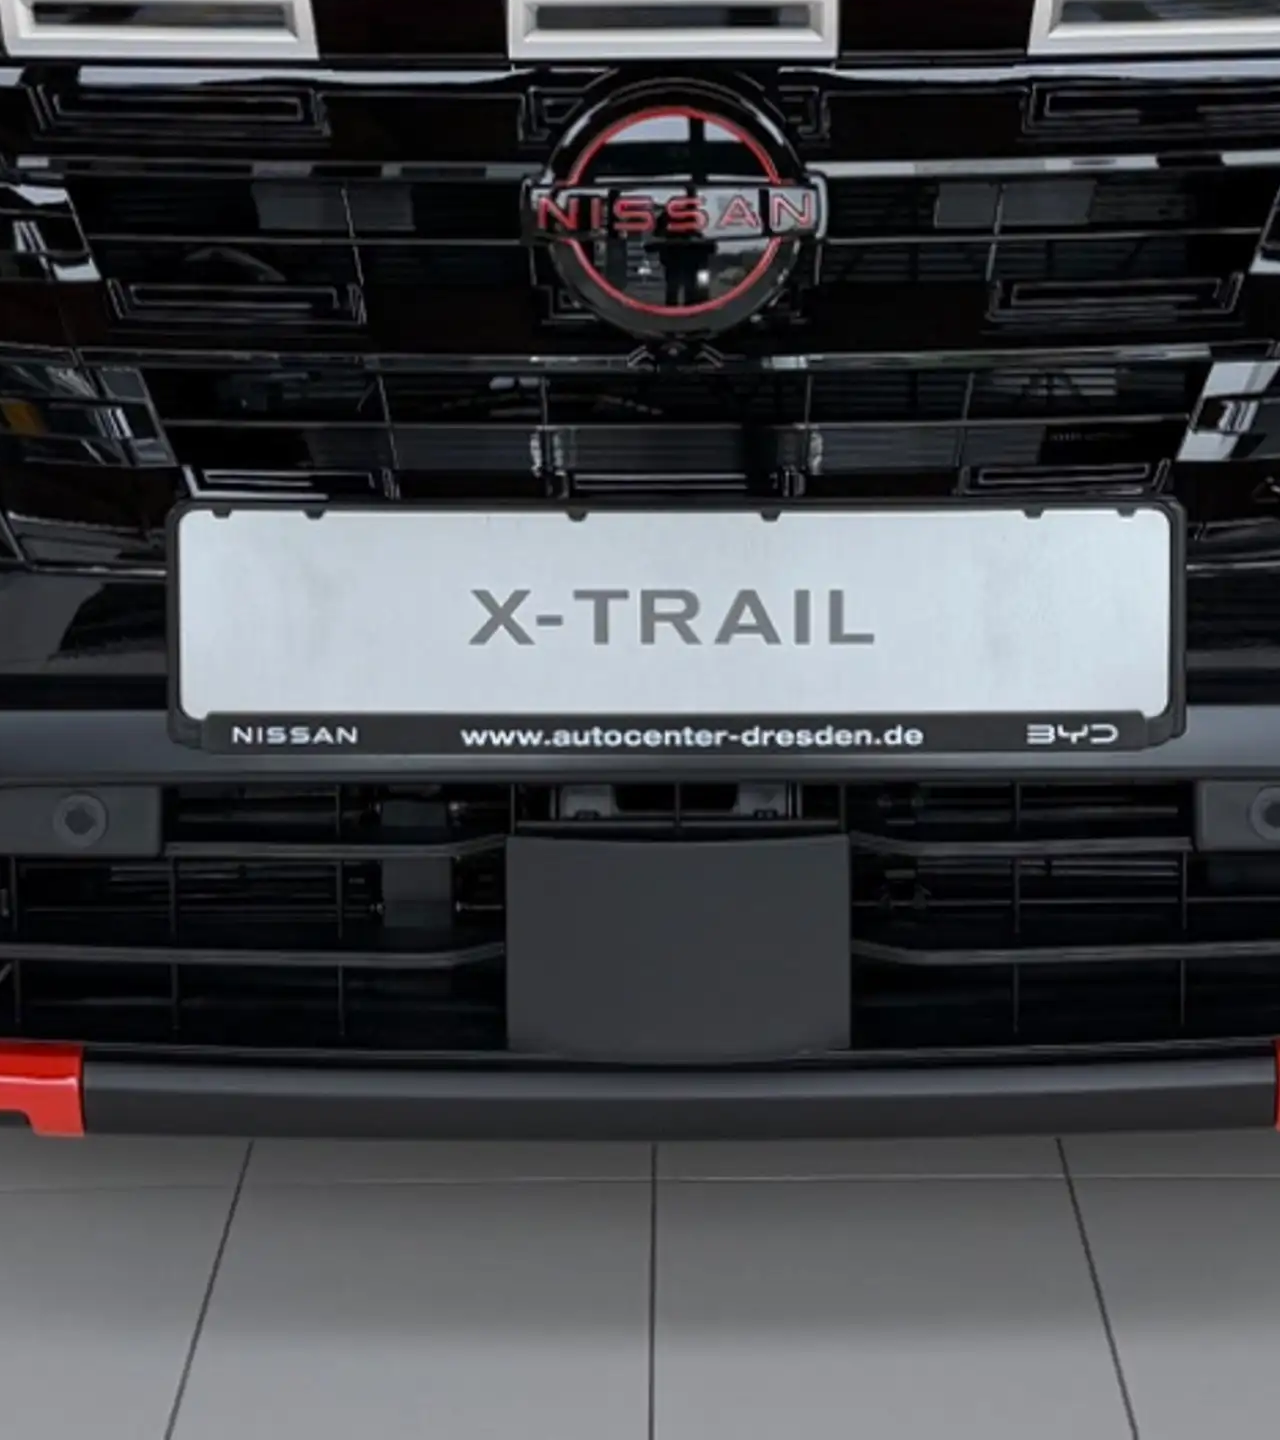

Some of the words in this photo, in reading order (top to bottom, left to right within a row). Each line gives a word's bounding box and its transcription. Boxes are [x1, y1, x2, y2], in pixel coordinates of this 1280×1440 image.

[536, 193, 813, 232] NISSAN
[468, 589, 876, 646] X-TRAIL
[231, 725, 359, 745] NISSAN
[460, 725, 924, 748] www.autocenter-dresden.de
[1026, 723, 1119, 744] BYD
